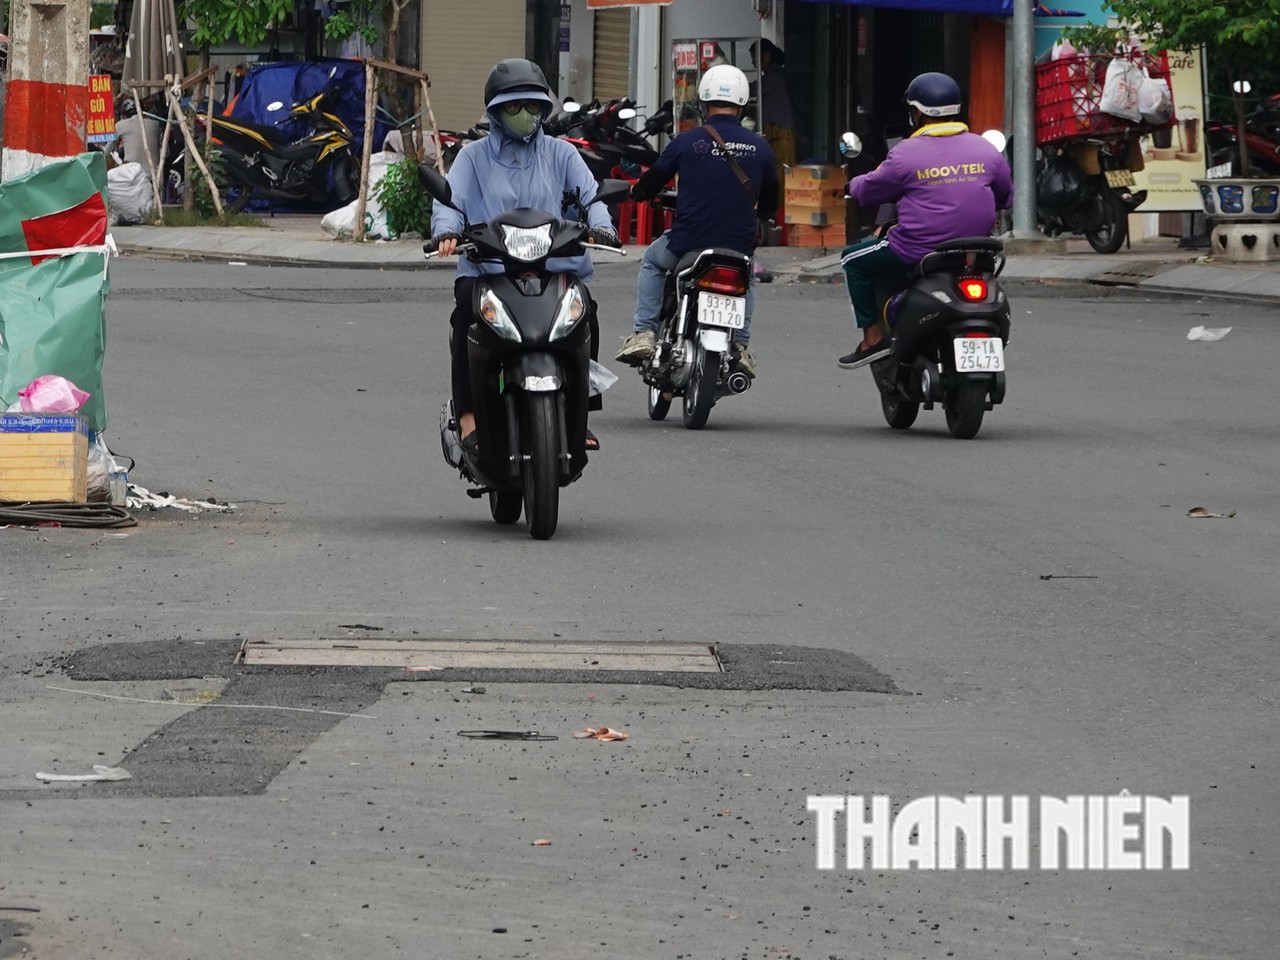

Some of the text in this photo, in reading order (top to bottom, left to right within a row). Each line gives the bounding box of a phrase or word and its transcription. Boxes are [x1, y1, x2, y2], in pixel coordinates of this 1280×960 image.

[92, 75, 111, 93] BÁN
[90, 93, 106, 113] GỬI
[712, 140, 756, 152] YSHINO
[916, 162, 986, 180] MOOVTEK
[707, 295, 737, 312] 93-PA
[703, 308, 741, 327] 111.20
[962, 341, 995, 354] 59-TA
[960, 355, 1000, 369] 254.73
